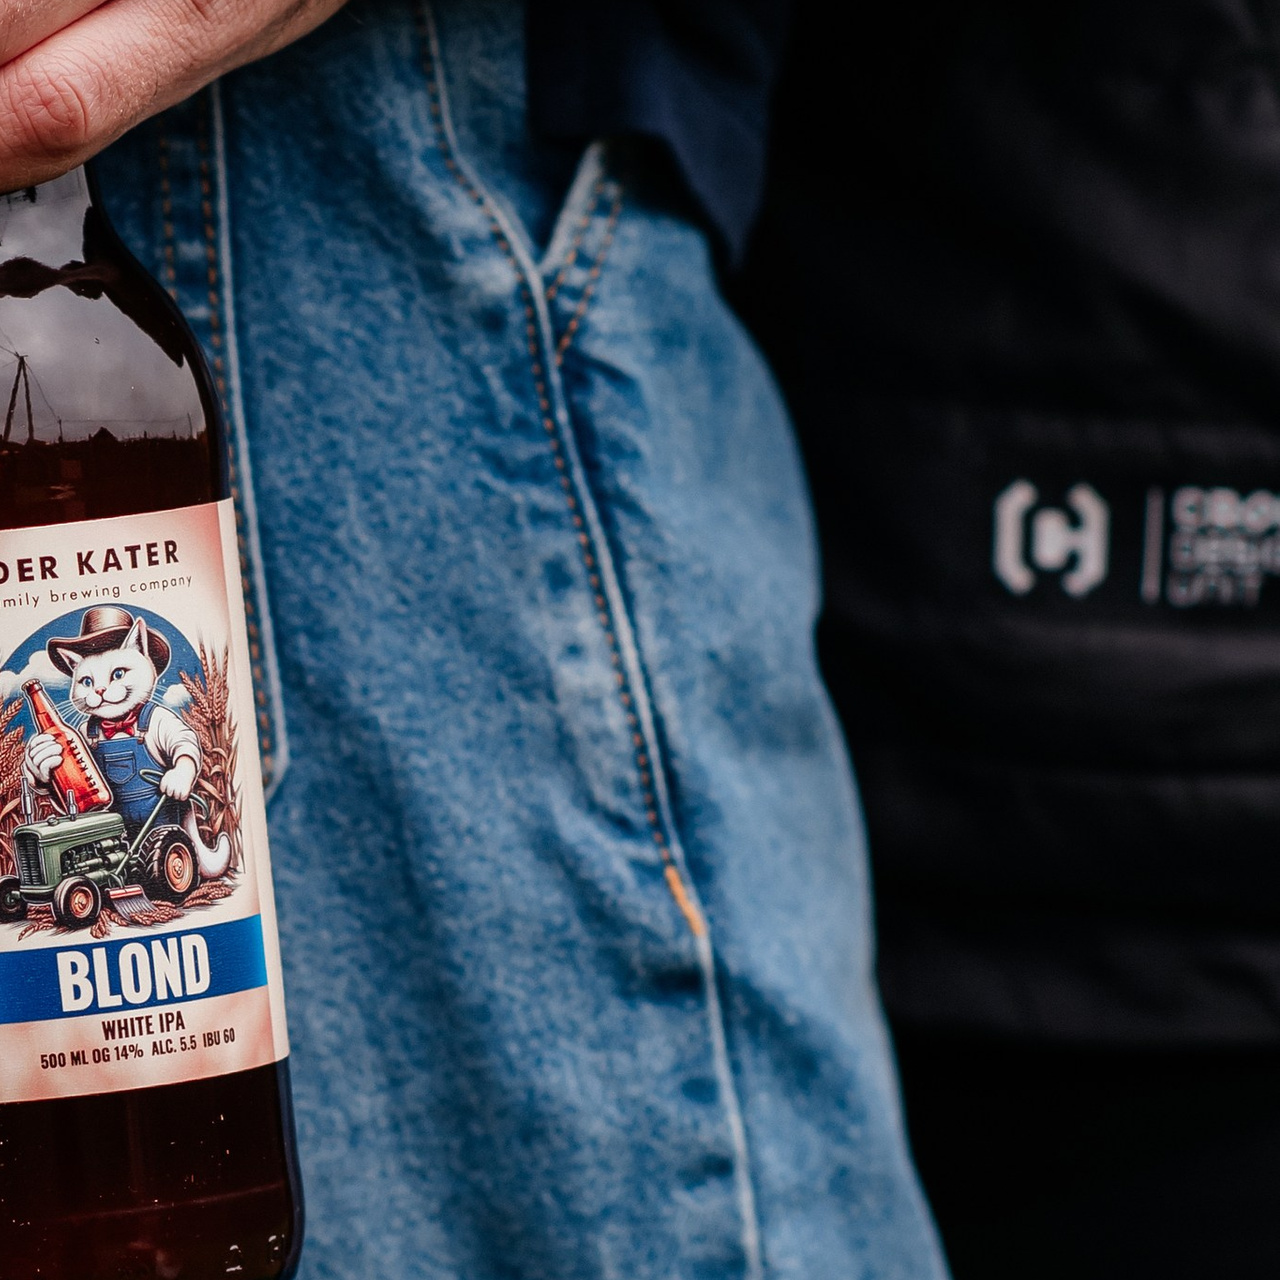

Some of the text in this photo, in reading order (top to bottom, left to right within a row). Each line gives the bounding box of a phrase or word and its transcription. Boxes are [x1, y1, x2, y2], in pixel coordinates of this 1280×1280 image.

[76, 539, 180, 576] KATER
[50, 585, 121, 603] brewing
[130, 574, 193, 593] company
[56, 933, 211, 1013] BLOND
[101, 1010, 186, 1041] WHITE IPA
[40, 1027, 236, 1069] 500 ML OG 14% ALC. 5.5 IBU 60
